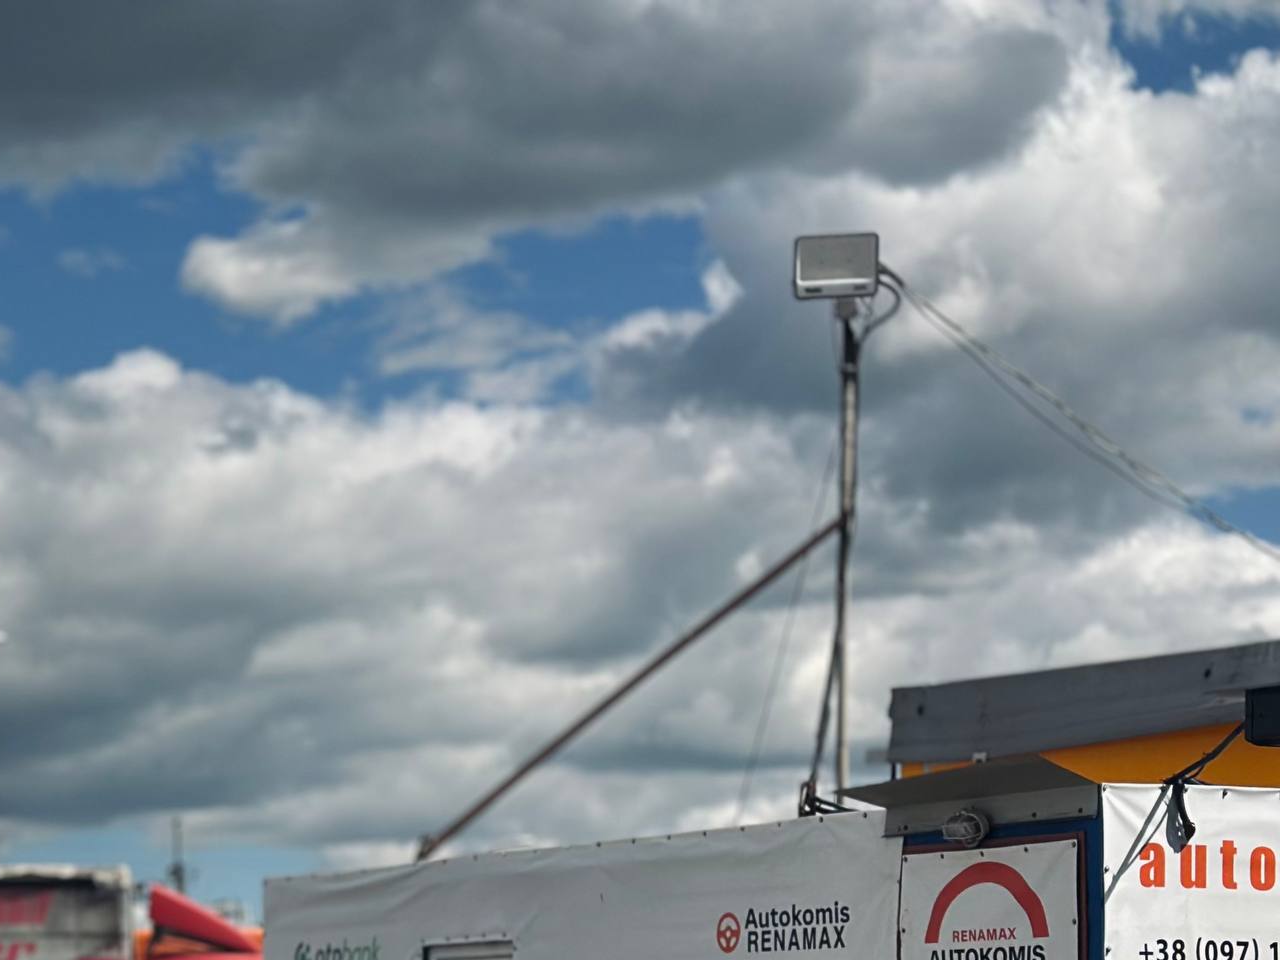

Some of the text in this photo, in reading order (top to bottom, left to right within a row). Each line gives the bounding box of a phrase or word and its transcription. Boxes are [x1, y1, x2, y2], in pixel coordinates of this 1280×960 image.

[1139, 840, 1276, 891] auto
[745, 901, 851, 929] Autokomis
[747, 925, 846, 952] RENAMAX
[952, 927, 1017, 943] RENAMAX
